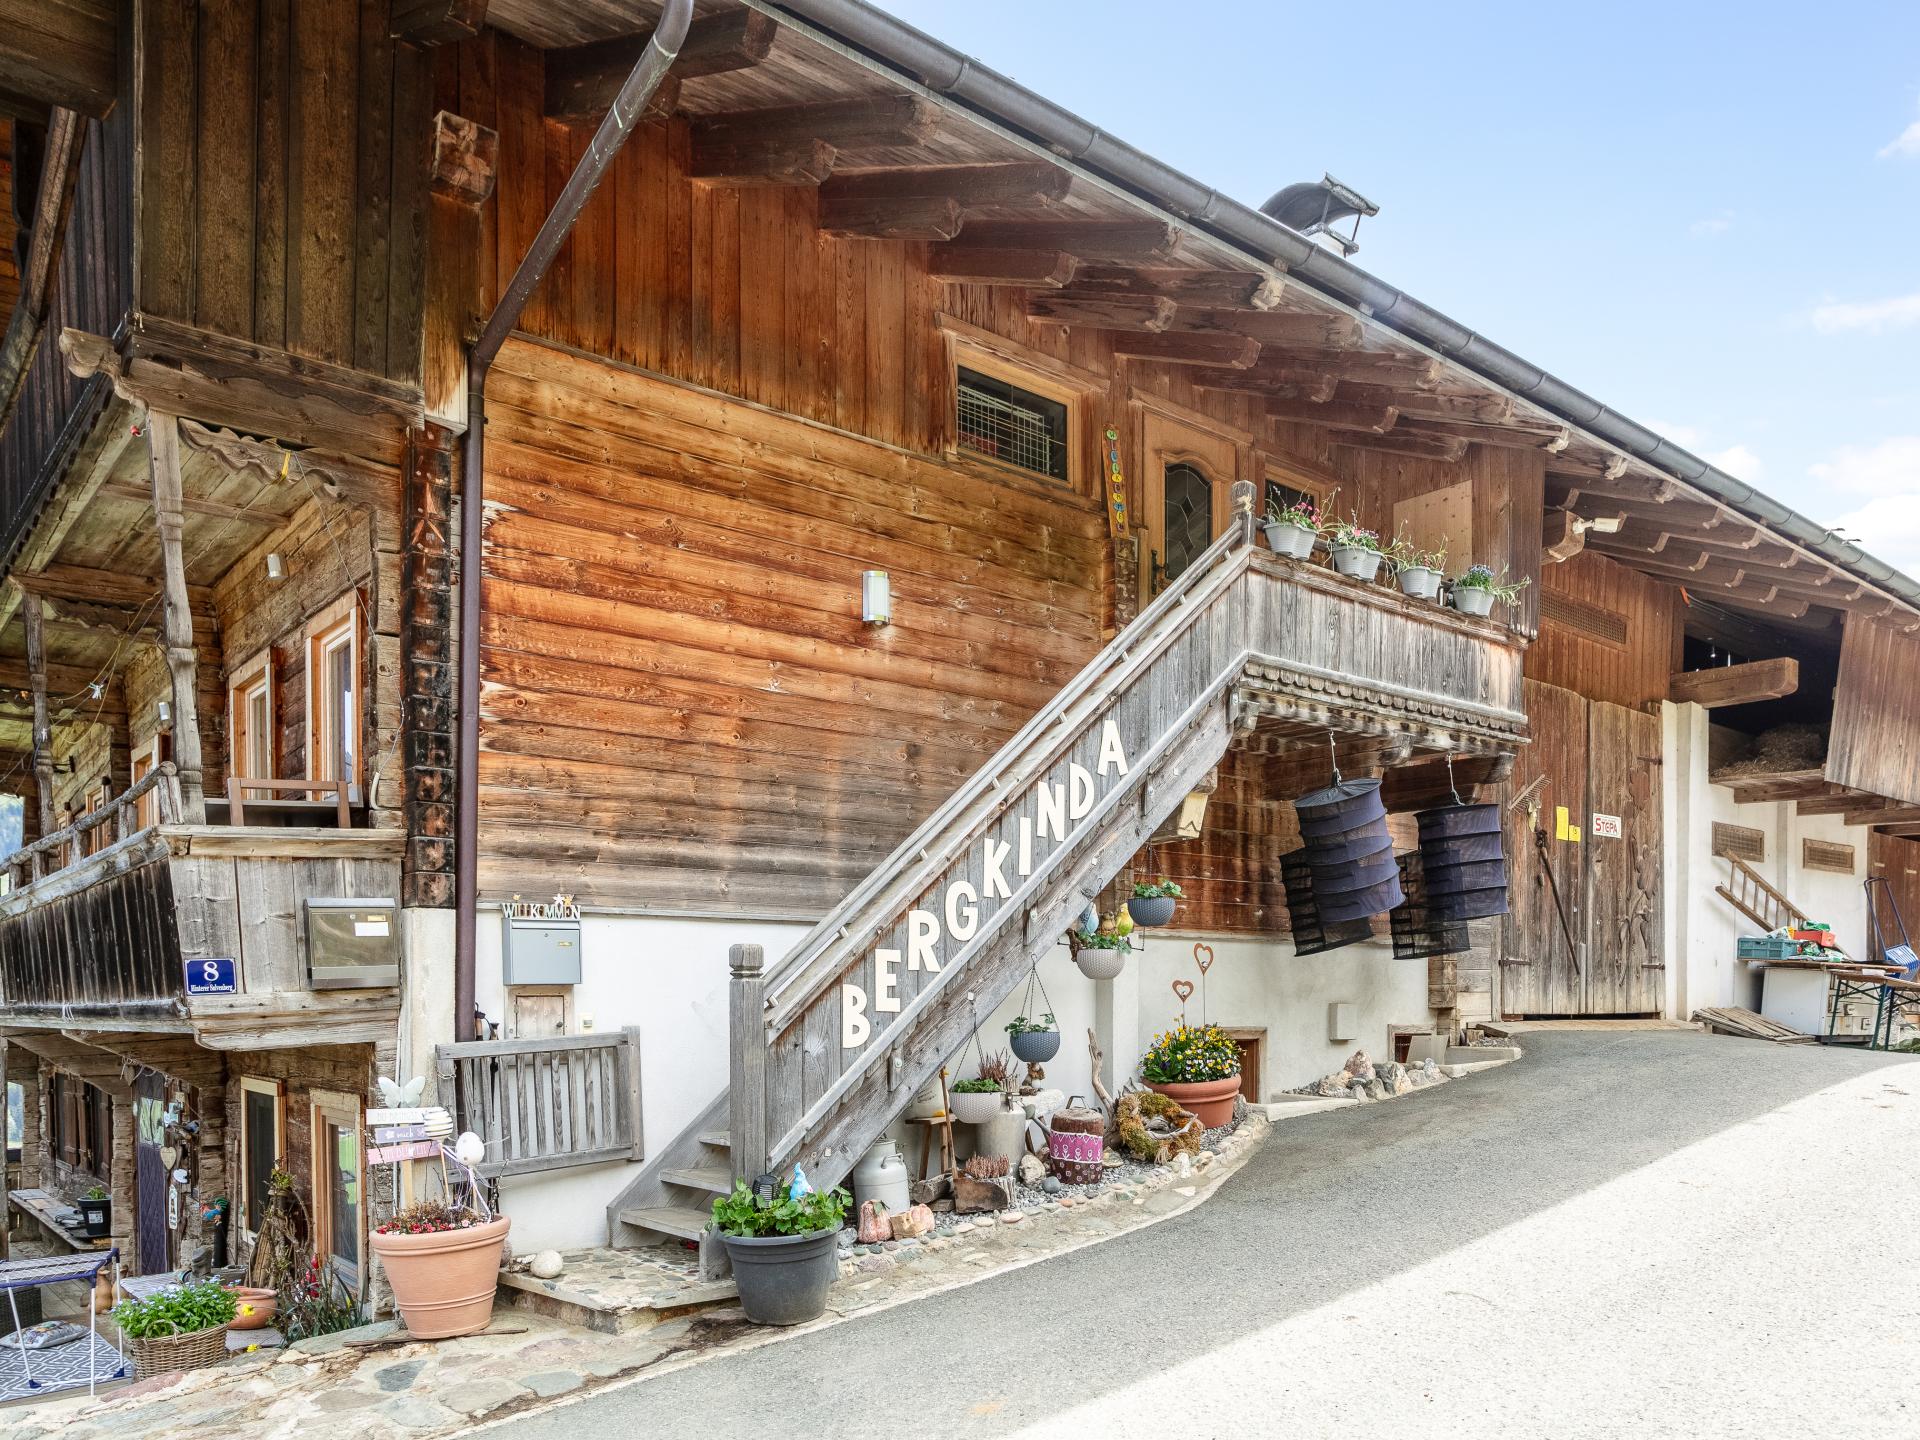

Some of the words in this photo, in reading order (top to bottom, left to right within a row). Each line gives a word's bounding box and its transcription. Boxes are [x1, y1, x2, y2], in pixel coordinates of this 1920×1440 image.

[842, 719, 1129, 1049] BERGKINDA
[502, 902, 581, 919] WILLKOMMEN
[203, 961, 219, 982] 8
